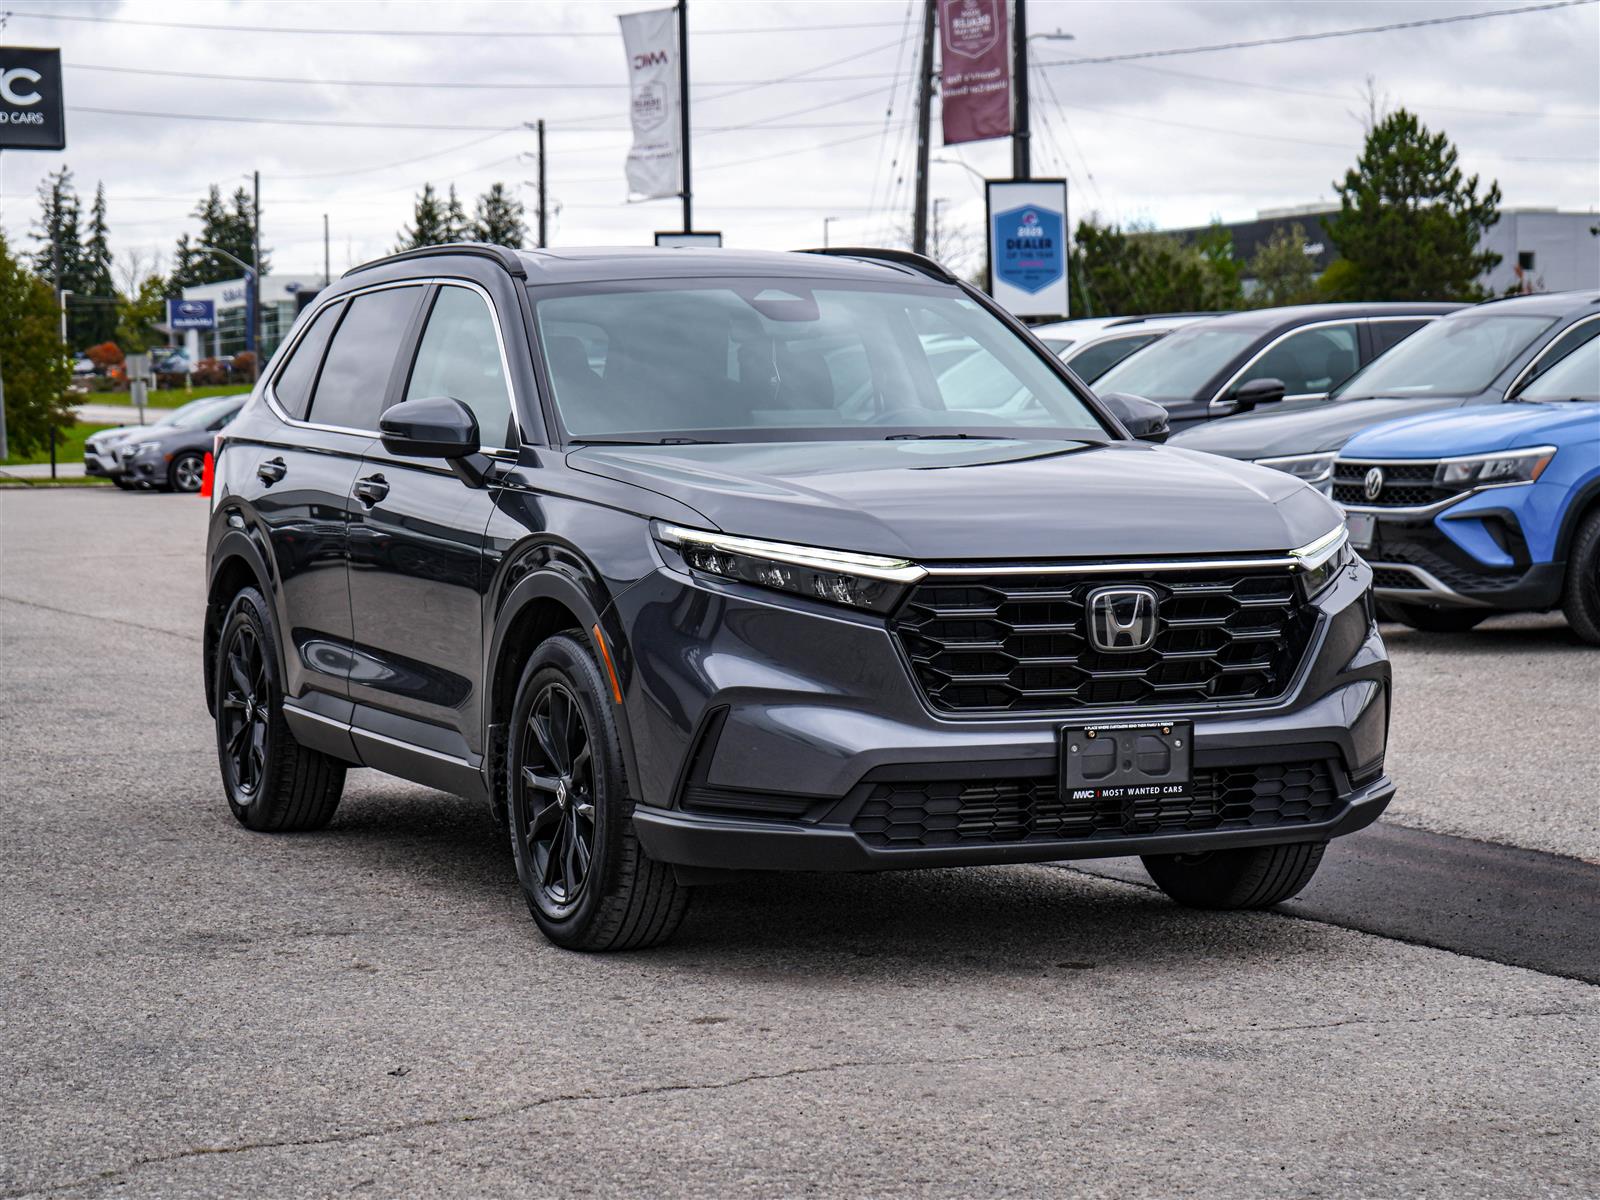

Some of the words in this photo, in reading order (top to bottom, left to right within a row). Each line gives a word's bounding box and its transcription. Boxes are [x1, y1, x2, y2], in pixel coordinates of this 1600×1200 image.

[10, 111, 45, 125] CARS
[1006, 238, 1053, 250] DEALER
[1102, 788, 1124, 797] MOST
[1127, 786, 1160, 796] WANTED
[1163, 785, 1183, 793] CARS
